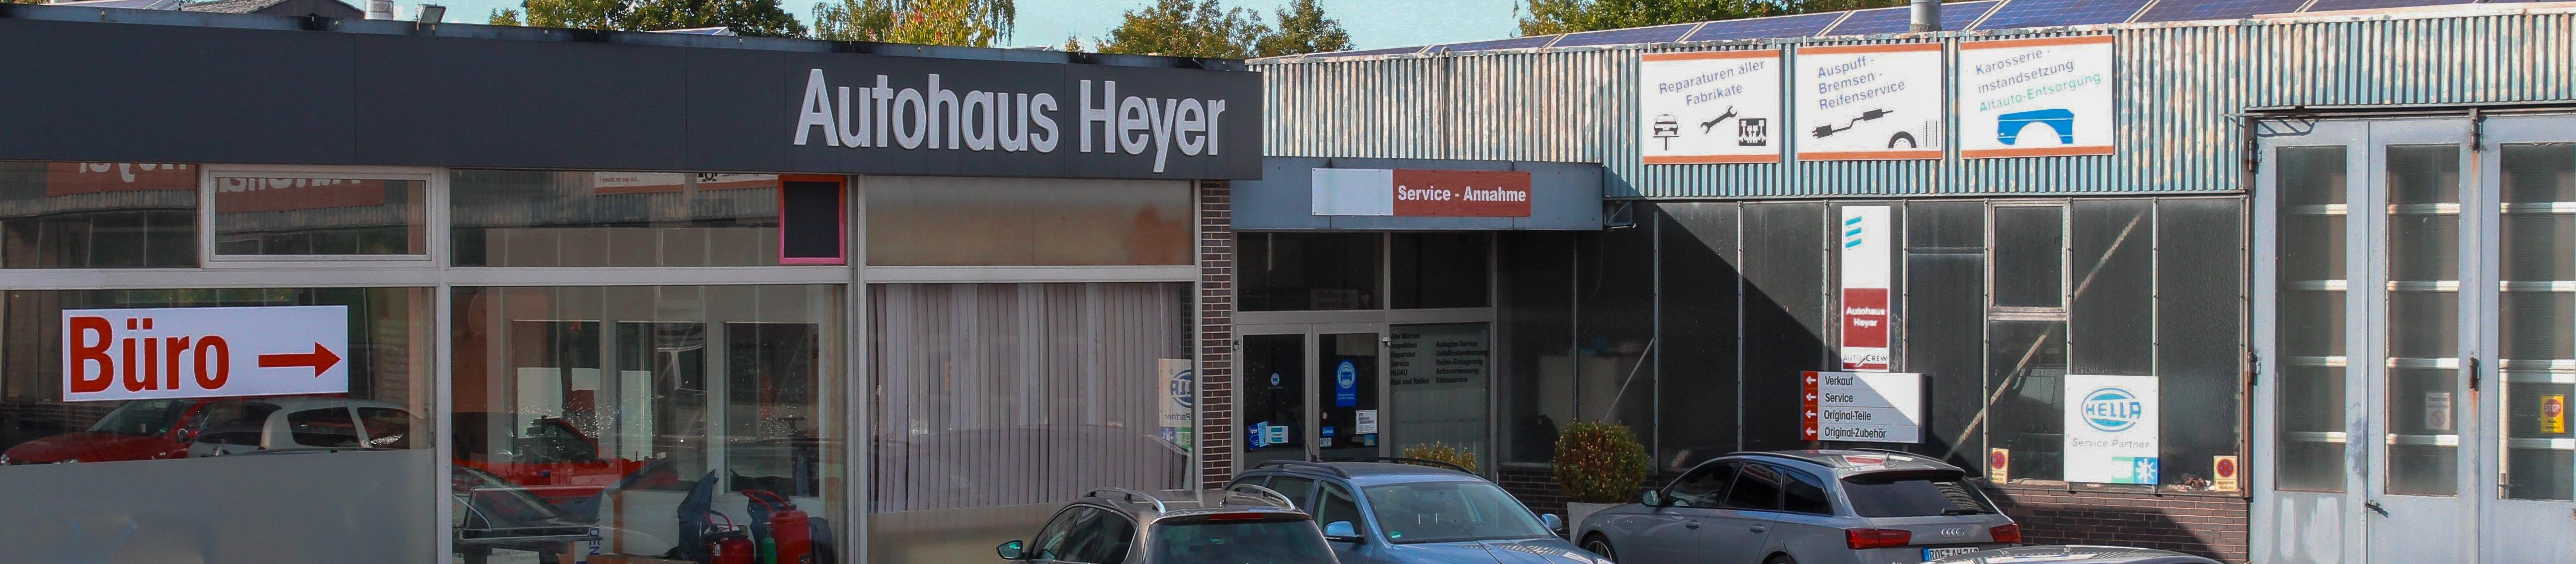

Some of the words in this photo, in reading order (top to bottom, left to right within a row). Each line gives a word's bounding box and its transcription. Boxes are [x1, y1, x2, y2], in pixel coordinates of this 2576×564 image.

[1818, 56, 1866, 78] Auspuff
[1976, 49, 2042, 75] Karosserie
[1659, 68, 1734, 94] Reparaturen
[1739, 60, 1765, 75] aller
[1819, 73, 1874, 94] Bremsen
[1978, 61, 2074, 94] instandsetzung
[1686, 84, 1743, 105] Fabrikate
[1819, 81, 1905, 110] Reifenservice
[1980, 74, 2100, 112] Altauto-Entsorgung
[794, 68, 1059, 153] Autohaus
[1079, 79, 1225, 174] Heyer
[1398, 185, 1450, 200] Service
[1463, 186, 1526, 201] Annahme
[1846, 306, 1886, 316] Autohaus
[1853, 318, 1878, 329] Heyer
[70, 316, 230, 393] Büro
[1825, 376, 1853, 386] Verkauf
[1825, 392, 1853, 402] Service
[1824, 410, 1871, 422] Original-Teile
[2086, 401, 2141, 419] HELLA
[1824, 427, 1886, 439] Original-Zubehör
[2072, 438, 2107, 448] Service
[2111, 439, 2150, 448] Partner
